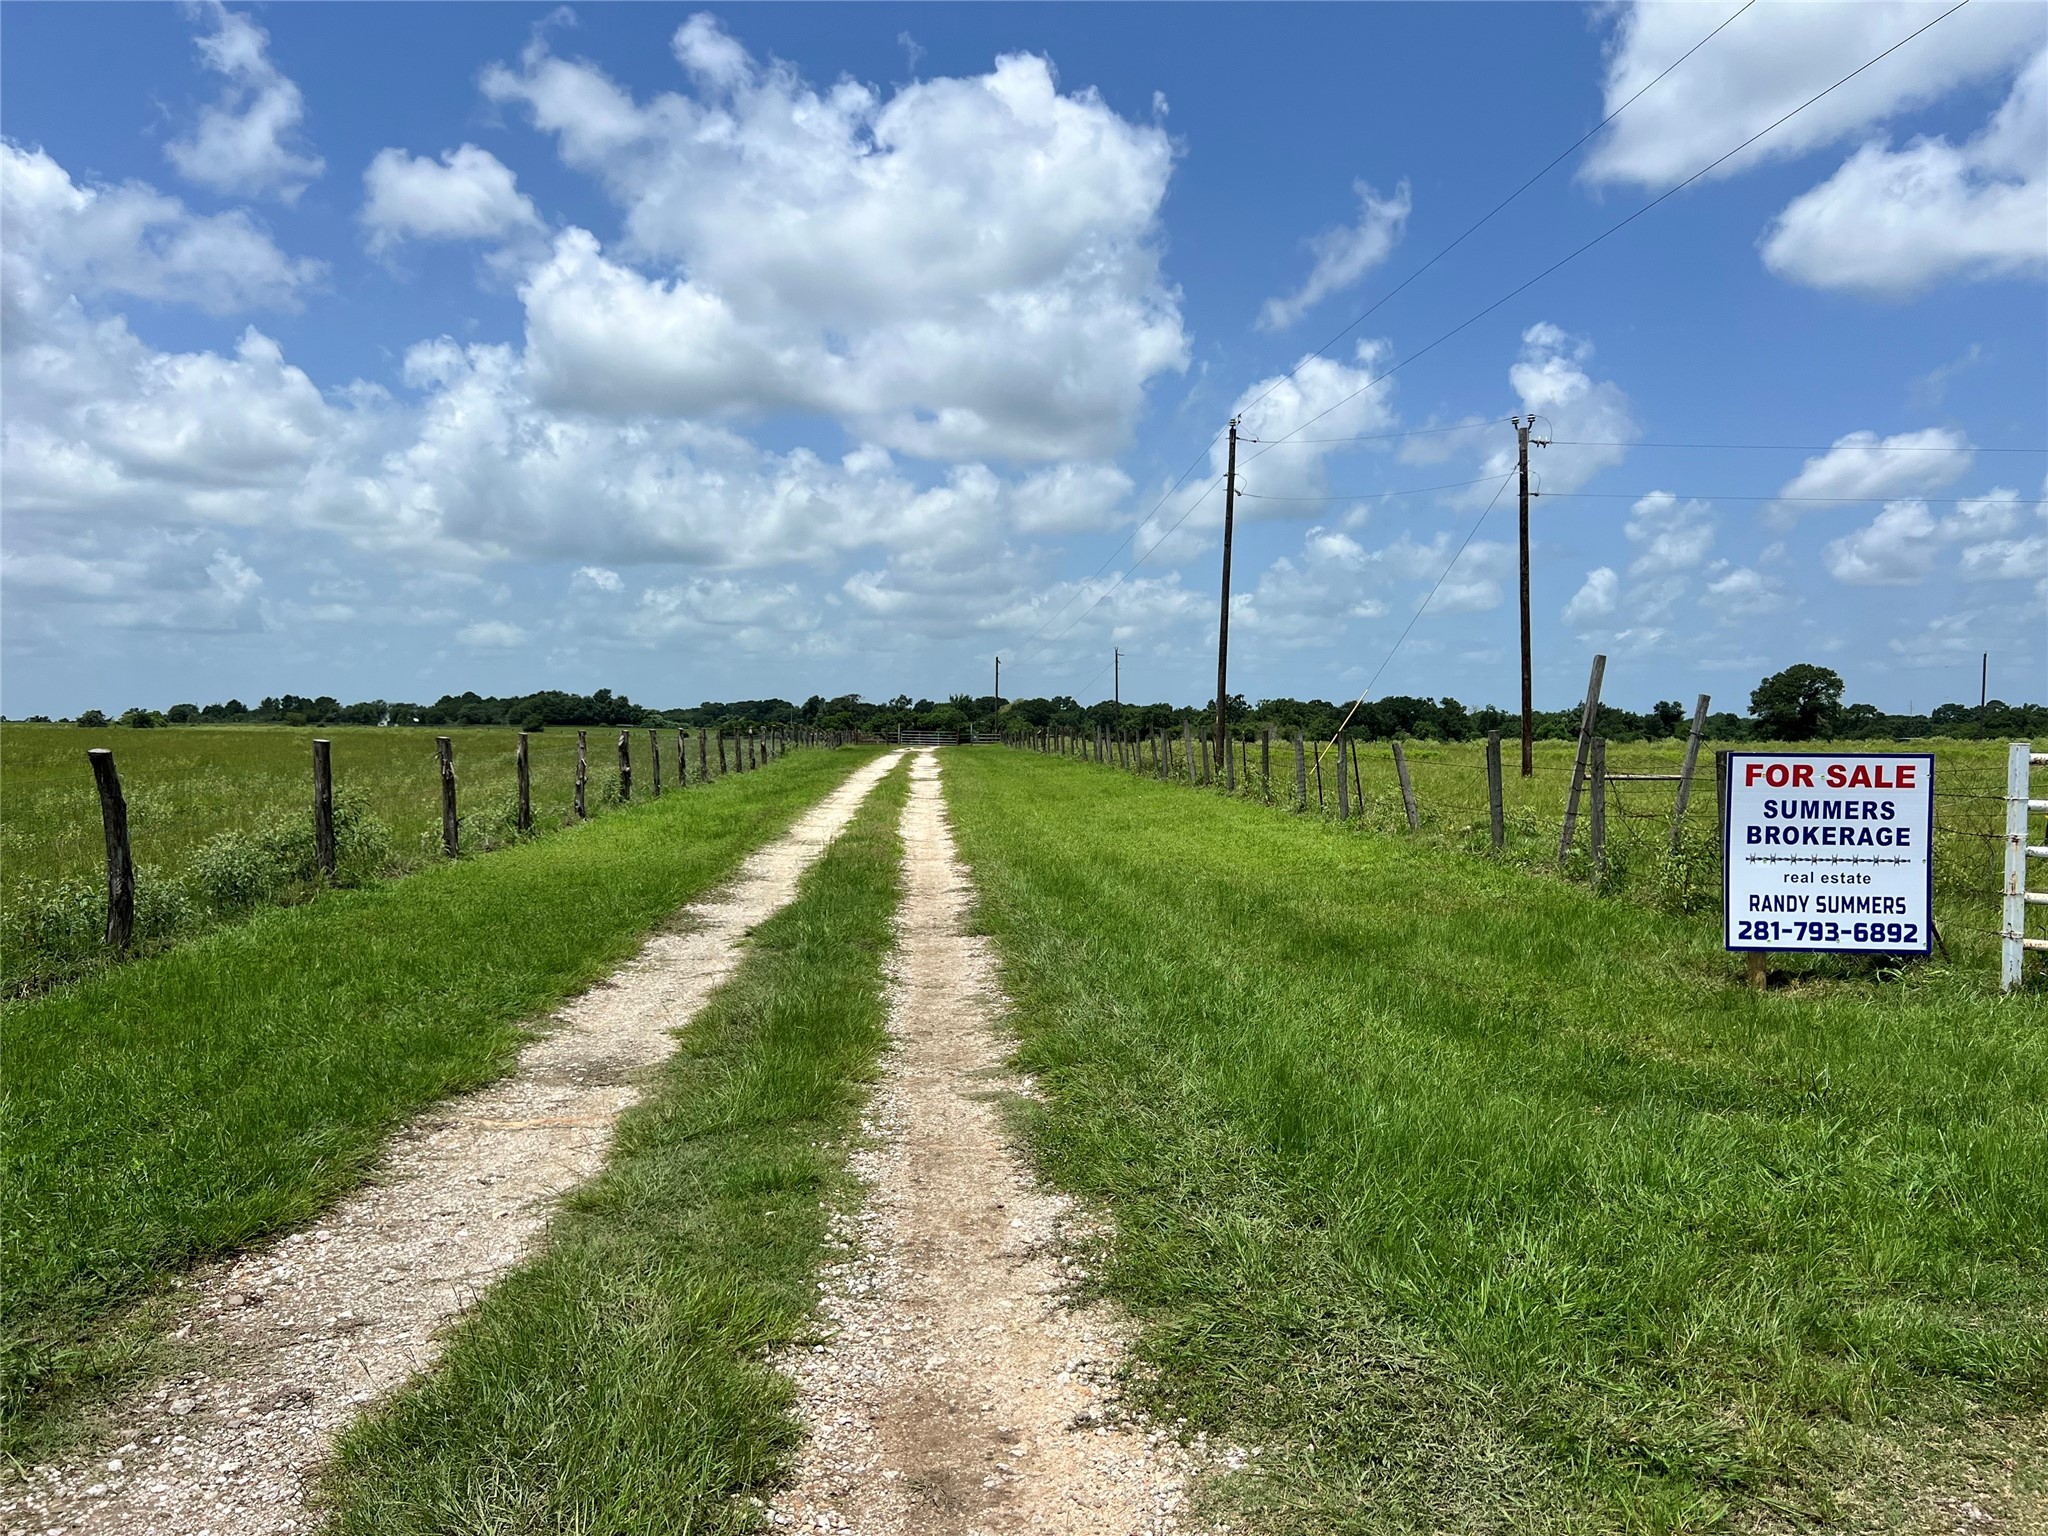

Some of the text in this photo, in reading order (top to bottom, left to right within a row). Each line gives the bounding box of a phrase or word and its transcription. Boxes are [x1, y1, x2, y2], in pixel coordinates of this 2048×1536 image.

[1745, 764, 1915, 788] FOR SALE
[1764, 800, 1895, 820] SUMMERS
[1747, 826, 1910, 846] BROKERAGE
[1784, 872, 1871, 884] real estate
[1750, 895, 1906, 914] RANDY SUMMERS
[1739, 920, 1918, 943] 281-793-6892
